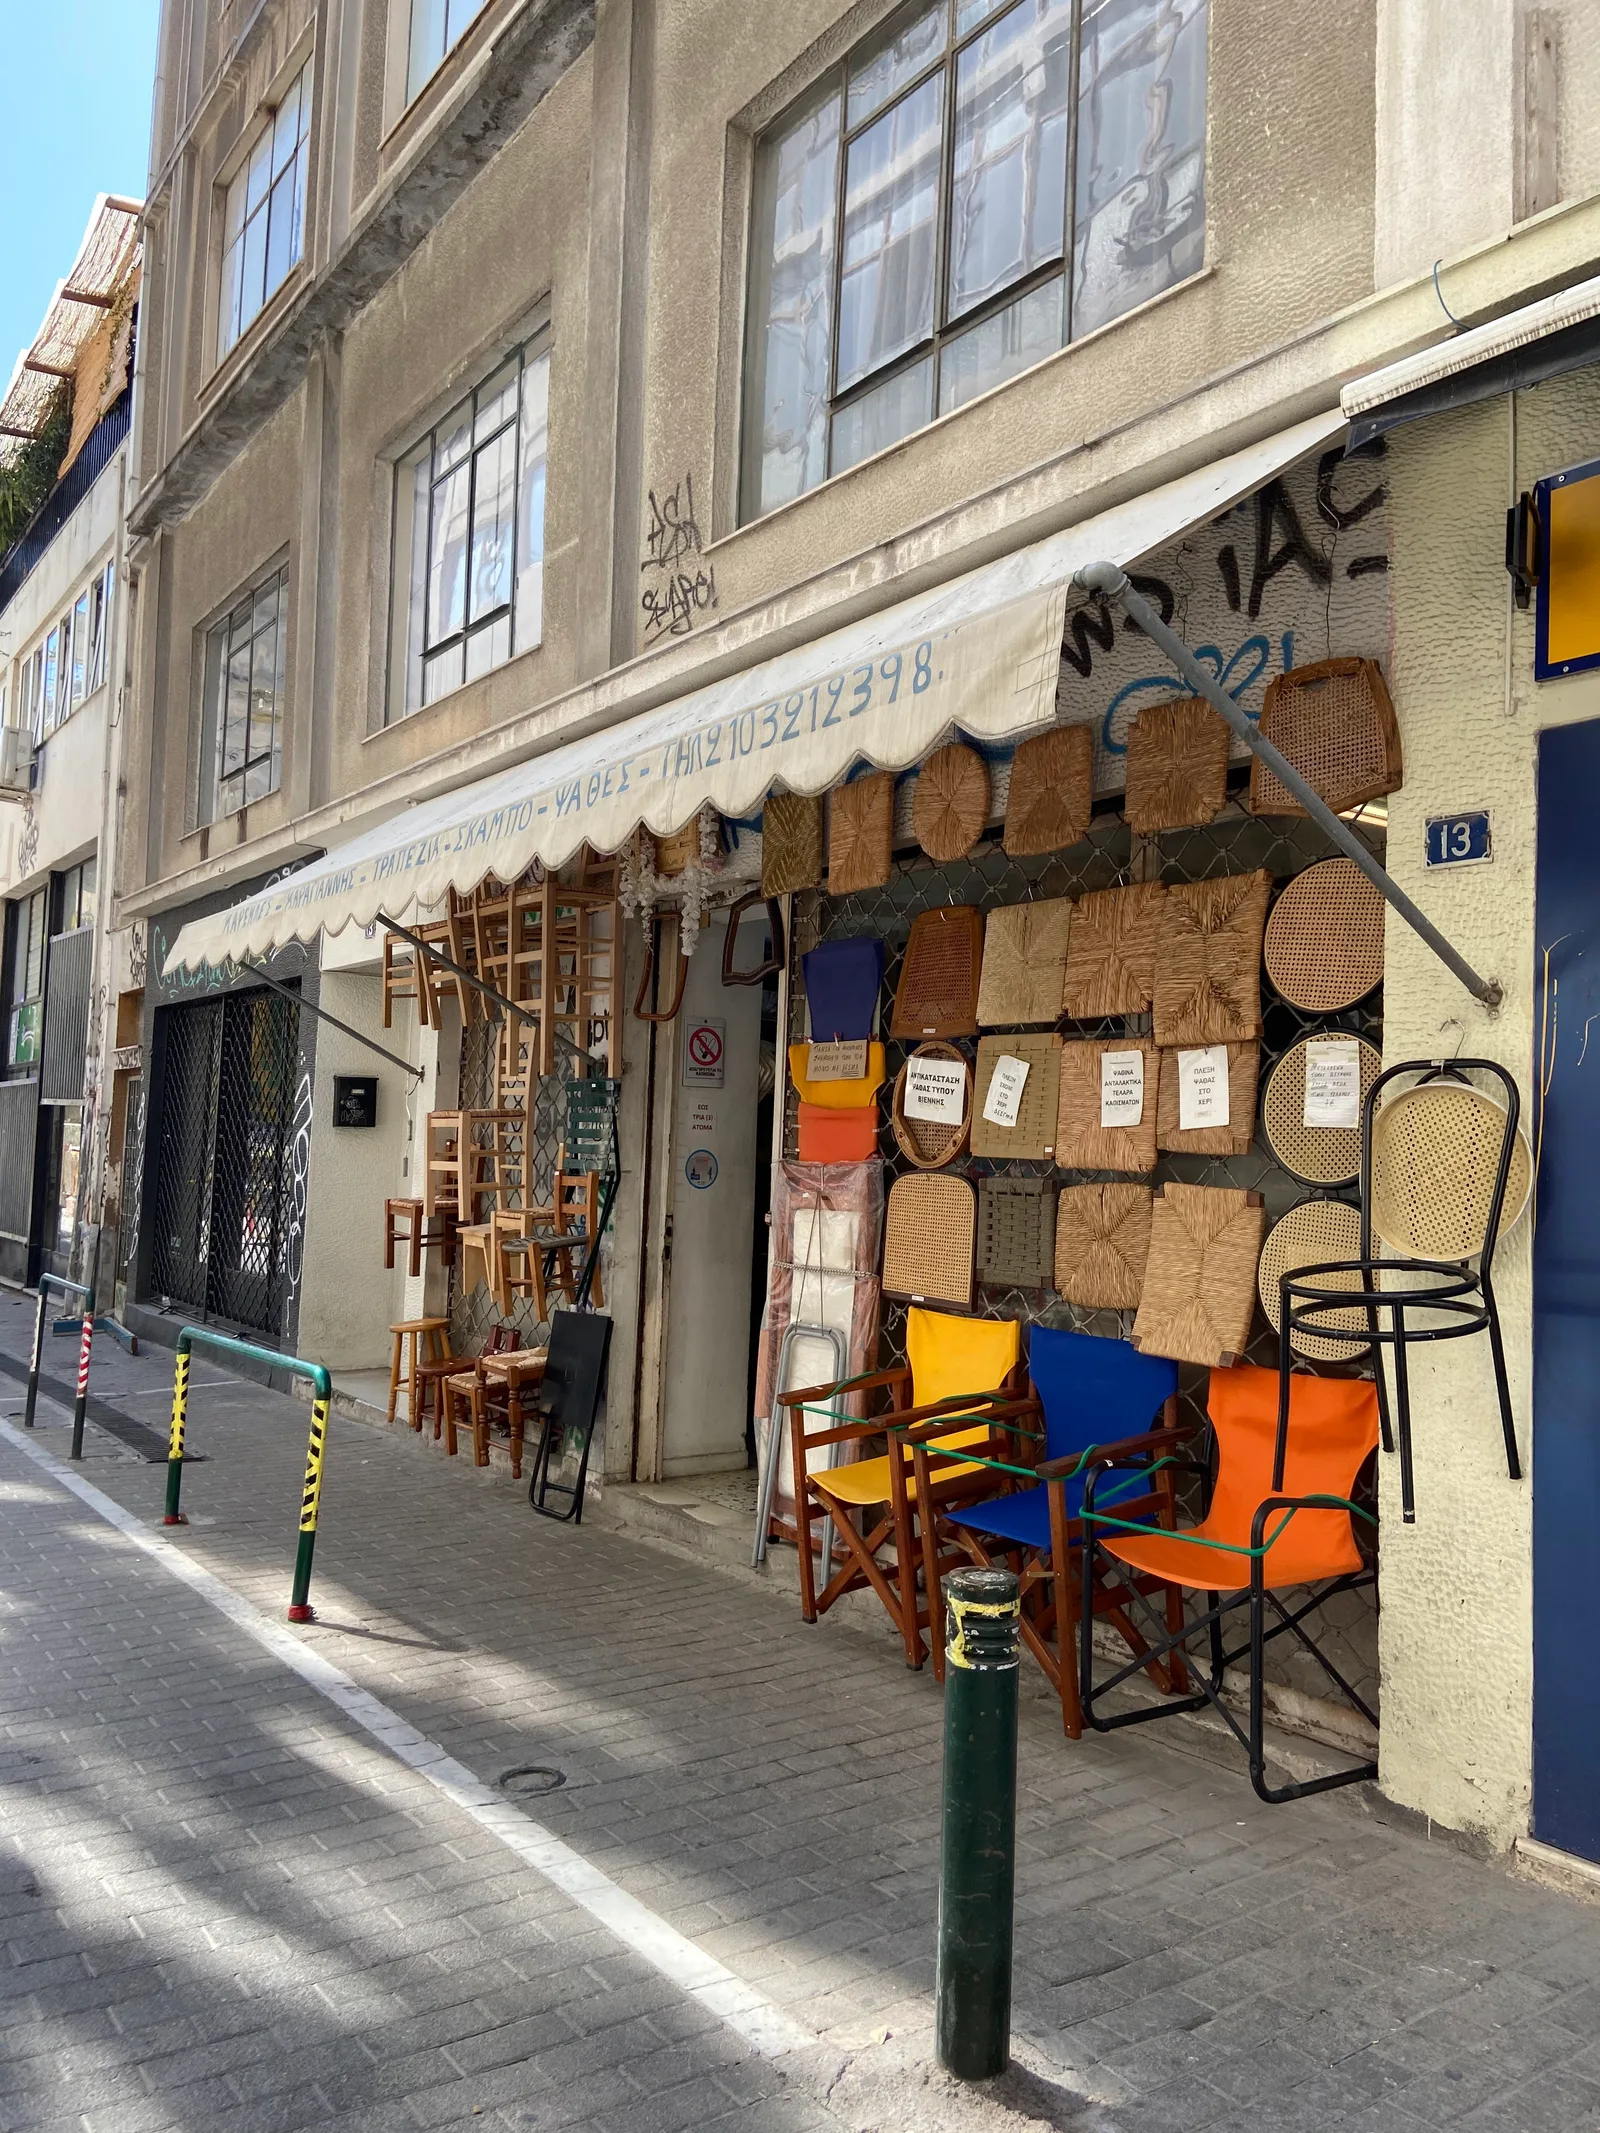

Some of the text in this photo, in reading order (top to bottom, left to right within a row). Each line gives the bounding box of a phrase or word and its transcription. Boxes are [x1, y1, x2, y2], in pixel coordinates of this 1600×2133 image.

[284, 867, 358, 911] ΚΑΡΑΓΙΑΝΝΗΣ
[373, 834, 440, 882] ΤΡΑΠΕΖΙΑ
[453, 799, 533, 853] ΣΚΑΜΠΟ
[555, 759, 635, 818] ΨΑΘΕΣ
[1440, 821, 1471, 859] 13
[1194, 1066, 1215, 1075] ΠΛΕΞΗ
[910, 1071, 960, 1084] ΑΝΤΙΚΑΤΑΣΤΑΣΗ
[1001, 1072, 1016, 1083] ΠΛΕΞΗ
[1193, 1077, 1216, 1085] ΨΑΘΑΣ
[932, 1085, 955, 1096] ΤΥΠΟΥ
[999, 1090, 1009, 1100] ΣΤΟ
[917, 1095, 945, 1106] ΒΙΕΝΝΗΣ
[996, 1100, 1007, 1109] ΧΕΡΙ
[1105, 1098, 1139, 1106] ΚΑΘΙΣΜΑΤΩΝ
[1197, 1098, 1212, 1106] ΧΕΡΙ
